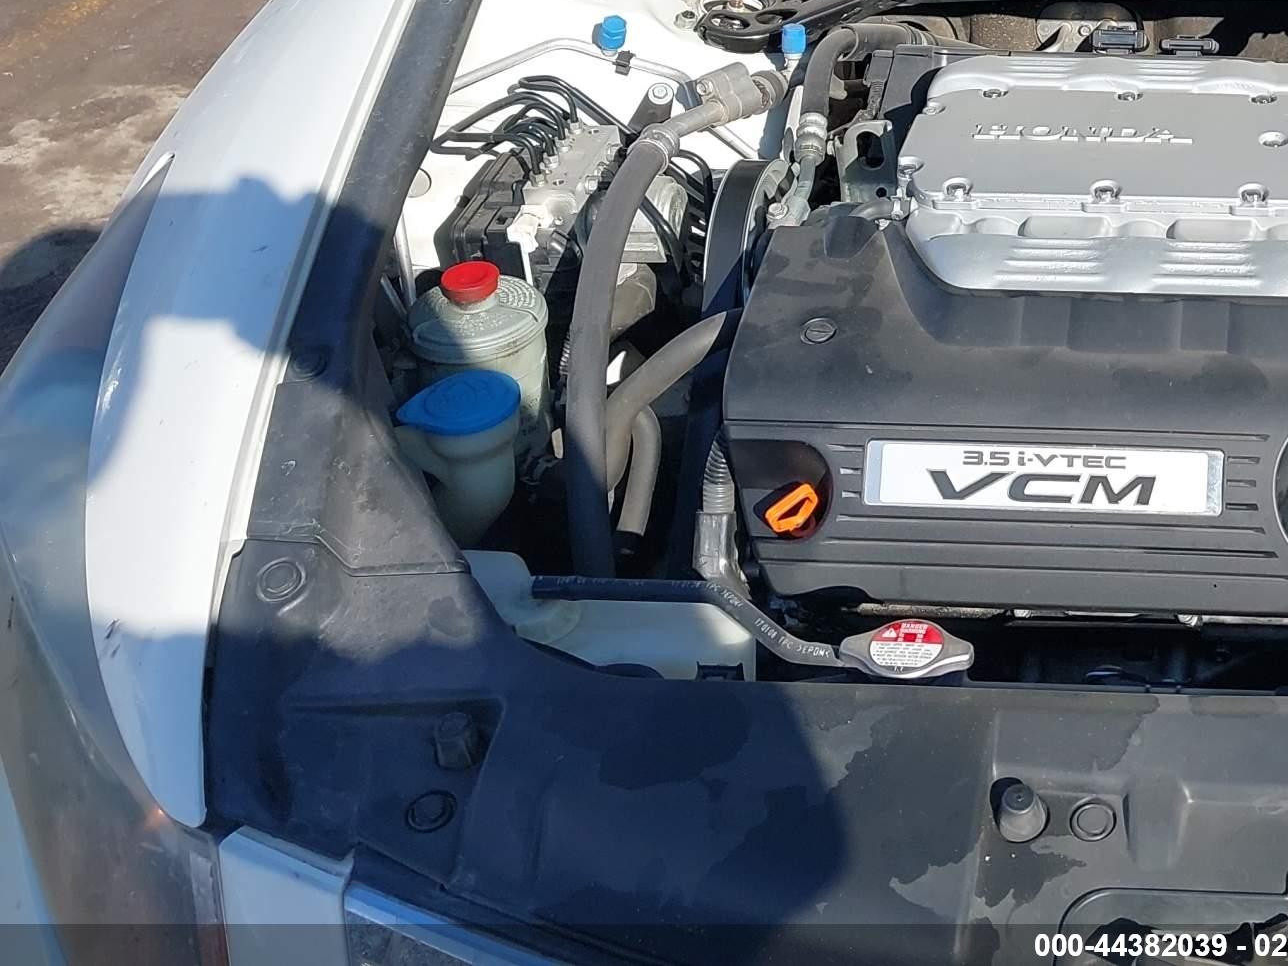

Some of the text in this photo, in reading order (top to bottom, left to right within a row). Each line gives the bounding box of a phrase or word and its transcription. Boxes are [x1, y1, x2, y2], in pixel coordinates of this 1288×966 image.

[972, 123, 1192, 144] HONDA
[962, 450, 1127, 469] 3.5 i-VTEC
[926, 468, 1157, 506] VCM
